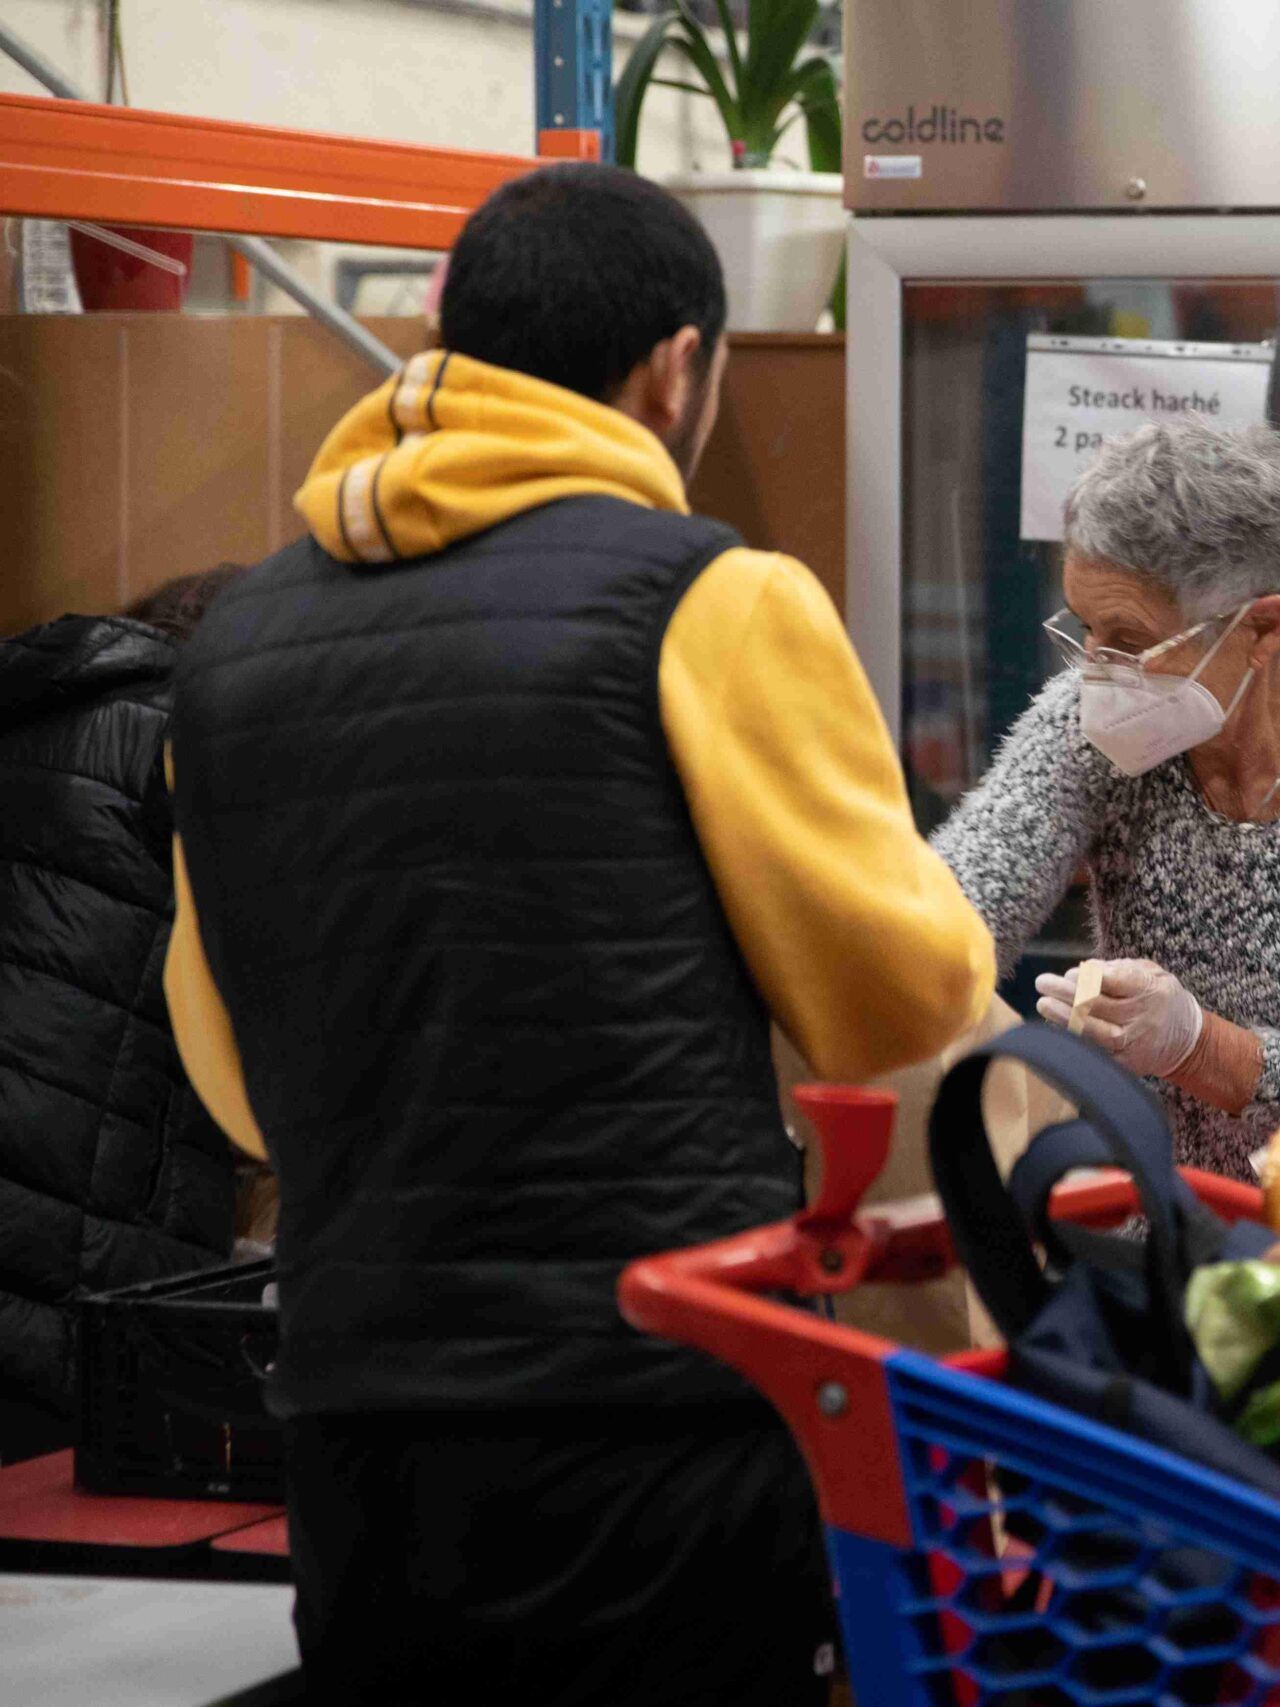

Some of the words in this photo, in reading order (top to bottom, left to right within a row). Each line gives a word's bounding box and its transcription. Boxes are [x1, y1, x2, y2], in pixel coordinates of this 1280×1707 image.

[862, 105, 1005, 143] coldline
[1068, 385, 1145, 410] Steack
[1152, 389, 1220, 415] haché
[1054, 426, 1067, 448] 2
[1075, 431, 1104, 453] pa
